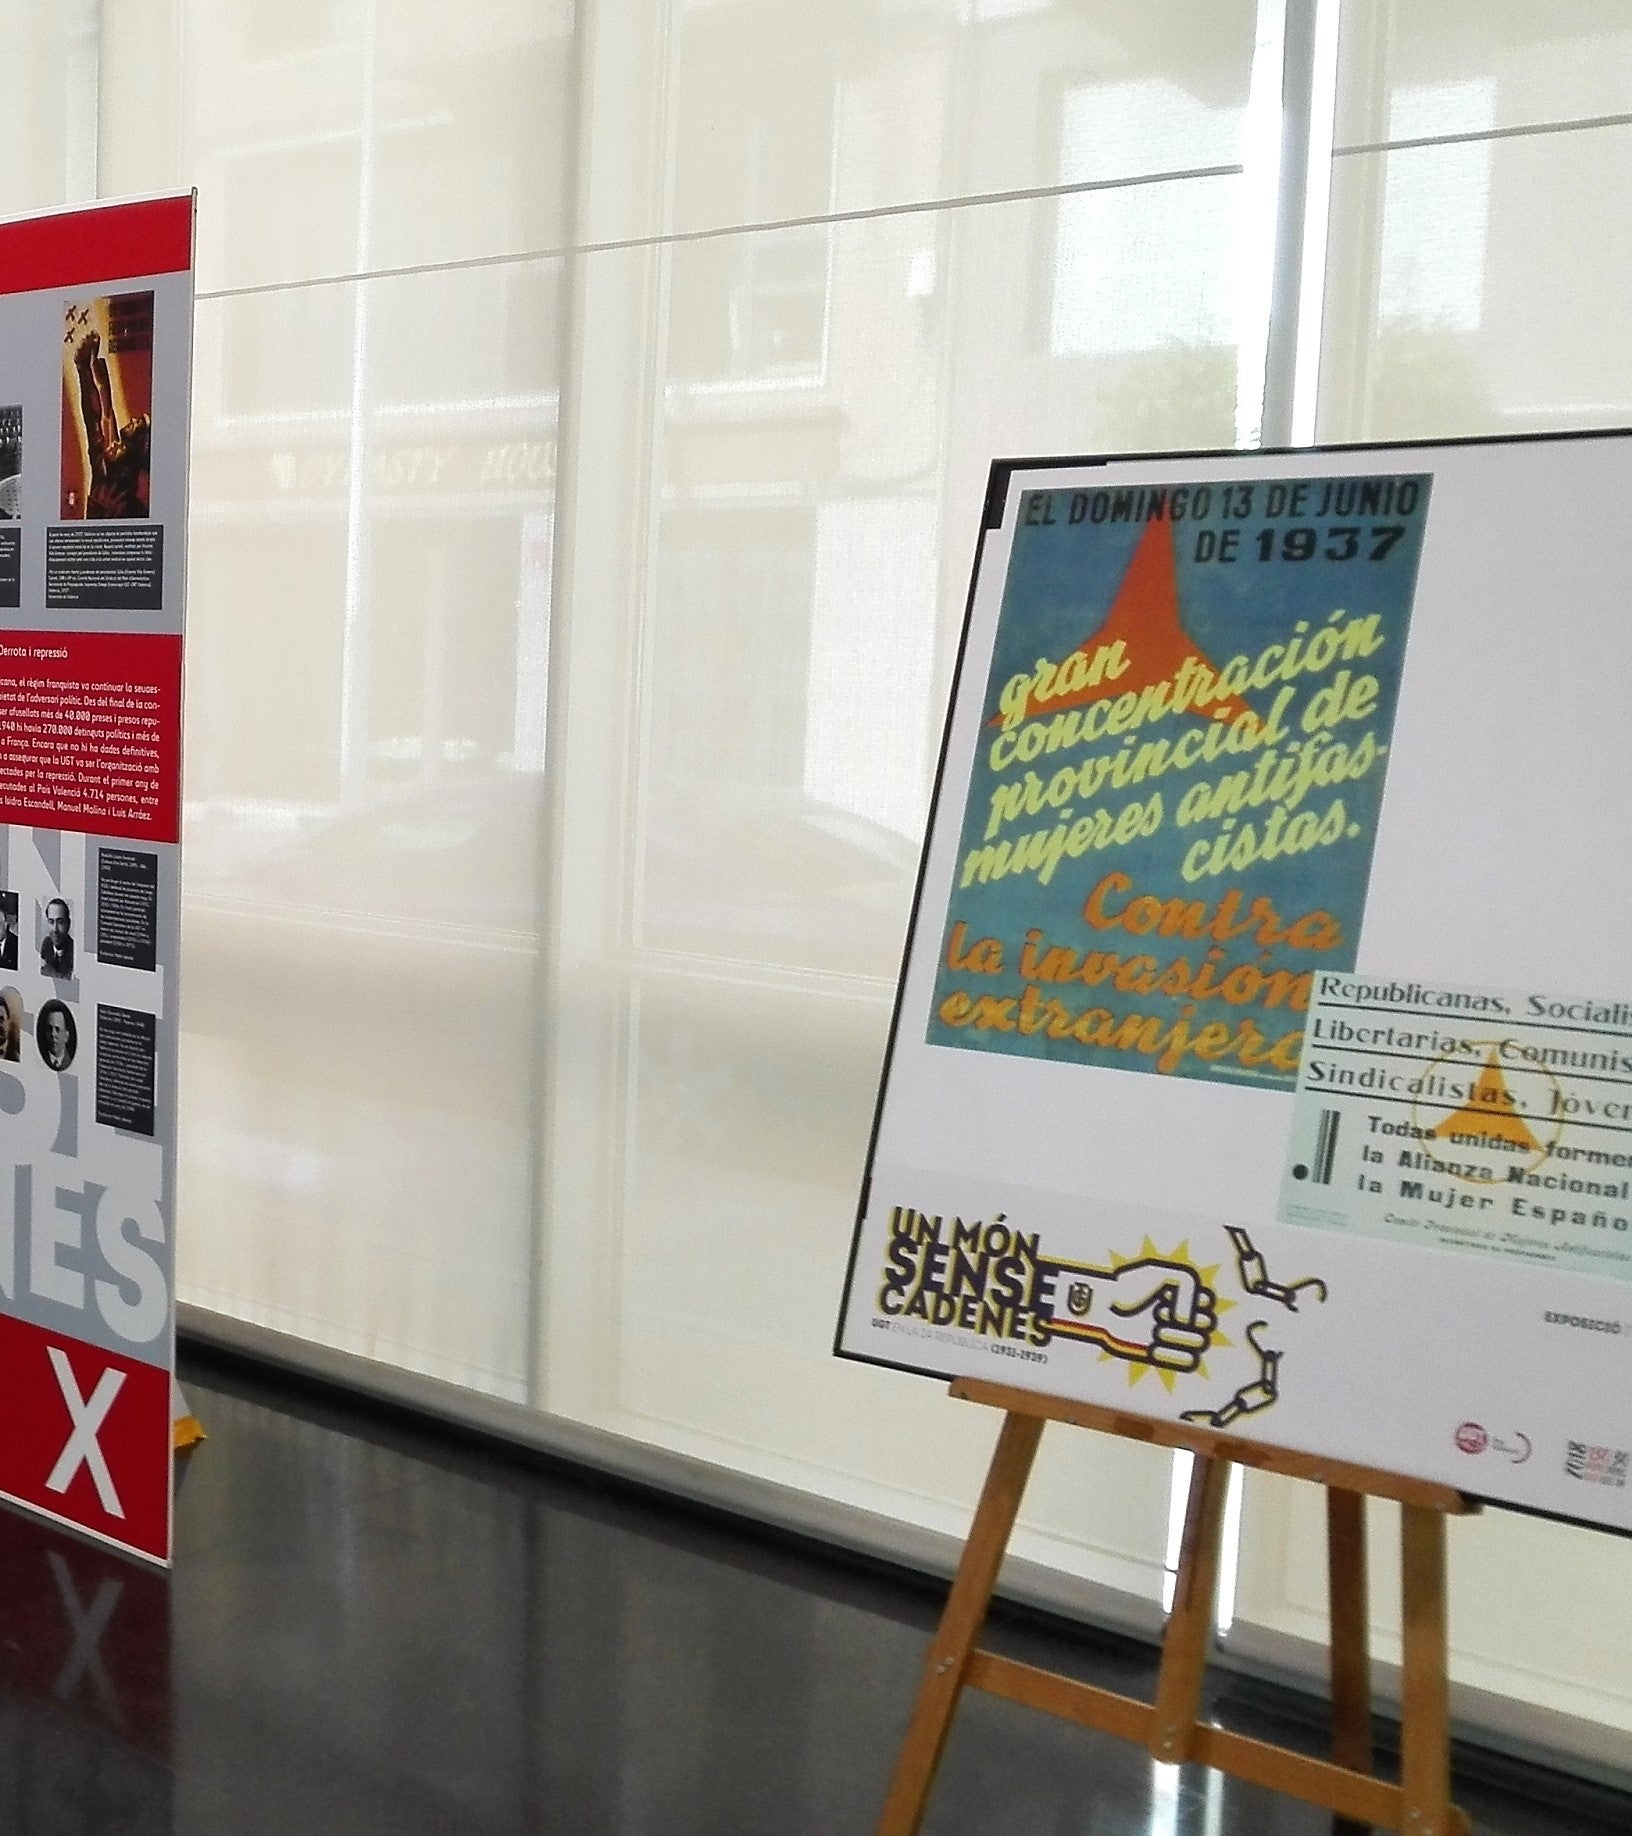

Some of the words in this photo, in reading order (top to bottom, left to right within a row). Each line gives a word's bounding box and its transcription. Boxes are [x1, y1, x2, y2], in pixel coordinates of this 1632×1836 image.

[1025, 491, 1056, 525] EL
[1069, 486, 1210, 525] DOMINGO
[1221, 485, 1256, 519] 13
[1266, 483, 1309, 518] DE
[1315, 480, 1419, 518] JUNIO
[1194, 529, 1239, 564] DE
[1256, 526, 1406, 562] 1937
[33, 646, 68, 660] repressió
[989, 609, 1385, 771] concentración
[999, 639, 1132, 732] gran
[985, 686, 1297, 840] provincial
[1301, 671, 1379, 733] de
[960, 792, 1164, 888] mujeres
[1181, 799, 1361, 883] cistas.
[1083, 871, 1343, 952] Contra
[947, 920, 1004, 976] la
[1019, 926, 1315, 1012] invasión
[1320, 976, 1511, 1015] Republicanas,
[1525, 994, 1632, 1027] Sociali
[1313, 1018, 1481, 1058] Libertarias,
[1306, 1060, 1527, 1108] Sindicalistas,
[1362, 1144, 1384, 1165] la
[1398, 1150, 1494, 1180] Alianza
[1507, 1166, 1630, 1200] Nacional
[1368, 1115, 1437, 1141] Todas
[1449, 1131, 1530, 1155] unidas
[1545, 1139, 1632, 1169] forme
[1357, 1173, 1383, 1194] la
[1400, 1180, 1494, 1211] Mujer
[889, 1206, 942, 1247] UN
[951, 1212, 1039, 1260] MÓN
[884, 1235, 1060, 1318] SENSE
[877, 1282, 1051, 1347] CADENES
[46, 1346, 127, 1520] X
